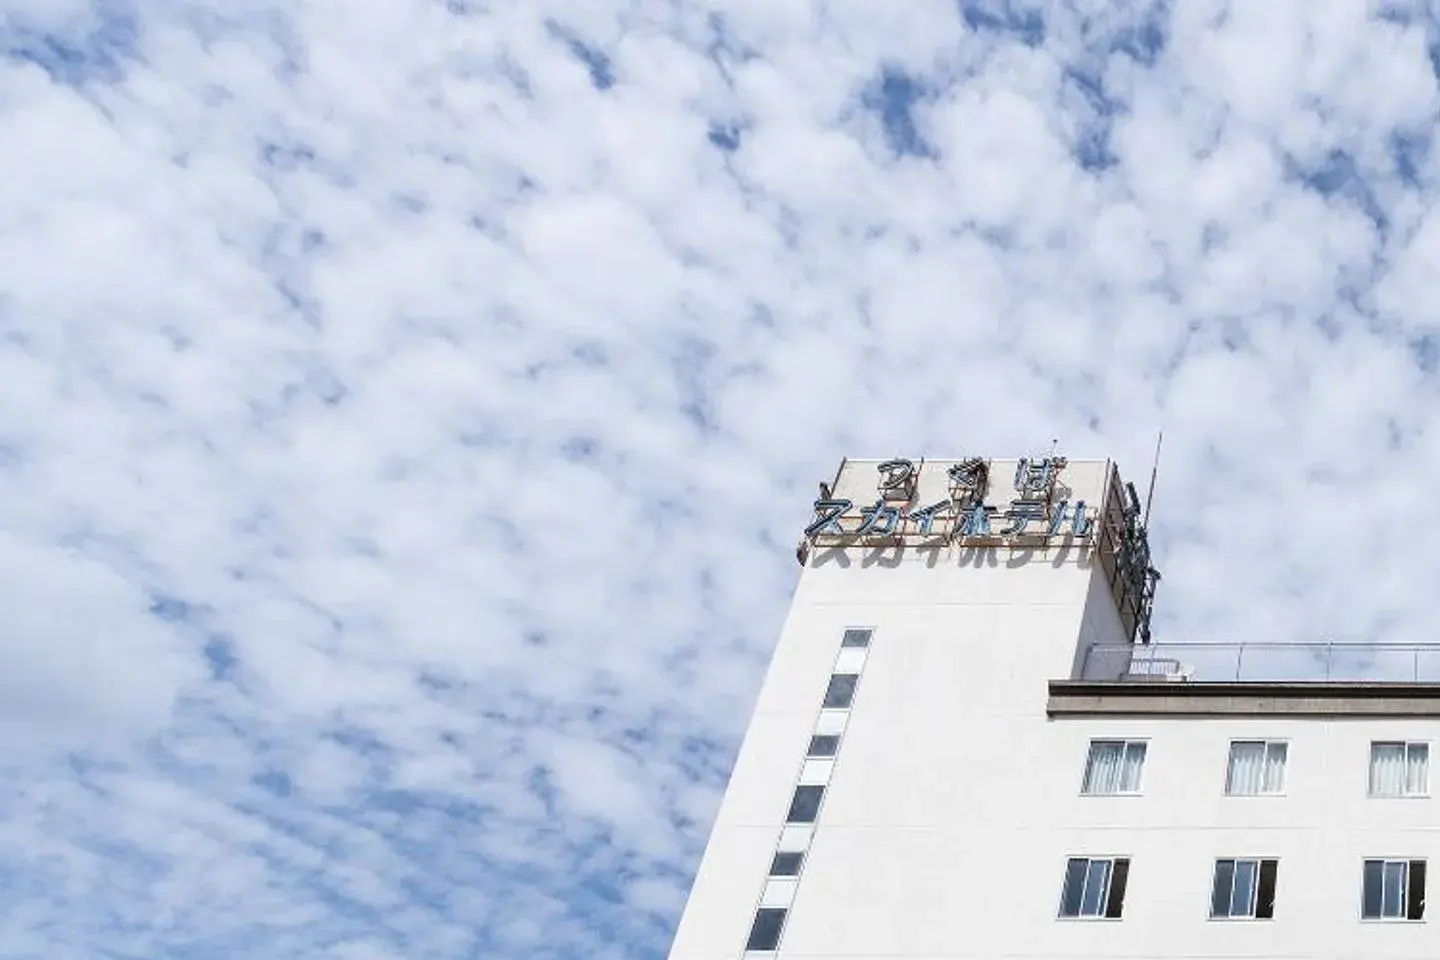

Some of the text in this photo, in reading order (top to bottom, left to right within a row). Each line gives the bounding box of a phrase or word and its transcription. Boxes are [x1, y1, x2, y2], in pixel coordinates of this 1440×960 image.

[804, 499, 1094, 537] スカイホテル
